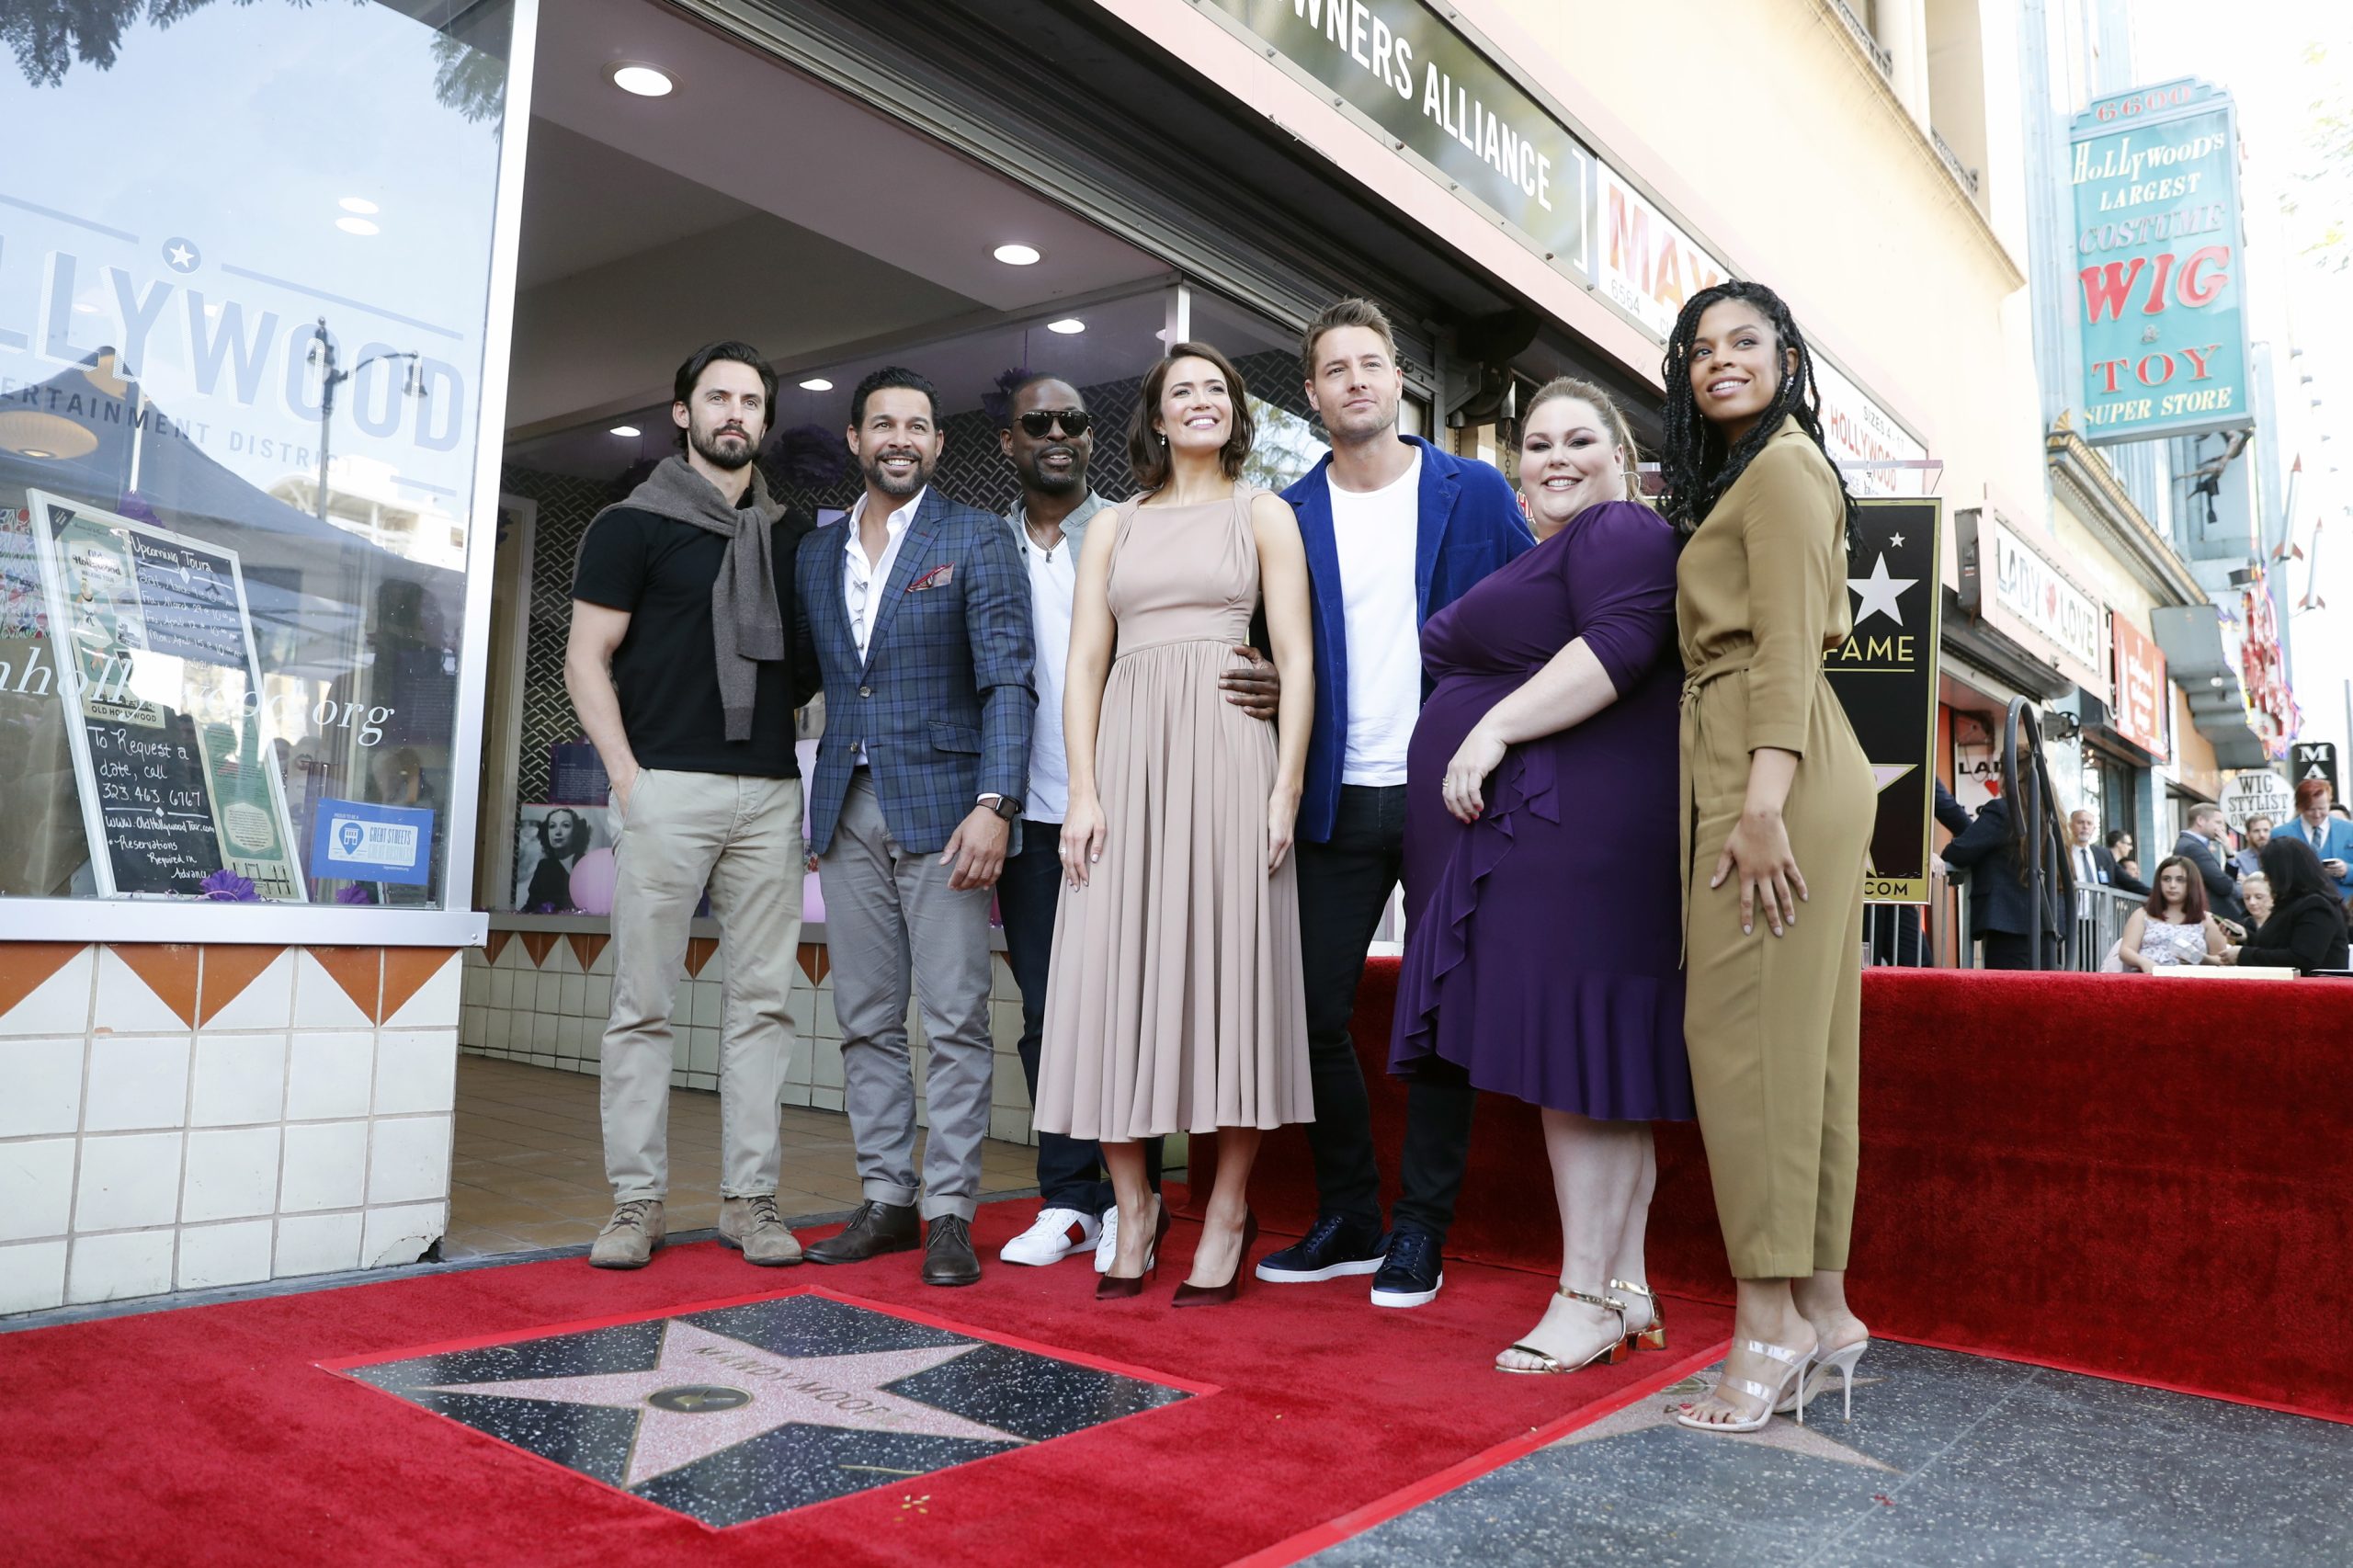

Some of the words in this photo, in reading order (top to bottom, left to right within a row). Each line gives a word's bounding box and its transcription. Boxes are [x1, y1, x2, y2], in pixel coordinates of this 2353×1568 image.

[1279, 0, 1414, 100] NERS
[1423, 61, 1552, 213] ALLIANCE
[2095, 85, 2192, 124] 6600
[2098, 171, 2201, 213] LARGEST
[2078, 200, 2226, 256] COSTUME
[1611, 278, 1641, 315] 6564
[2078, 244, 2231, 324] WIG
[2140, 324, 2161, 345] &
[2091, 344, 2222, 395] TOY
[1863, 405, 1885, 436] SIZES
[2084, 398, 2152, 427] SUPER
[2160, 386, 2233, 417] STORE
[1830, 403, 1897, 492] HOLLYWOOD
[131, 535, 180, 570] Upcoming
[1996, 537, 2040, 618] LADY
[2061, 590, 2095, 657] LOVE
[92, 705, 108, 715] OLD
[87, 726, 108, 749] To
[110, 728, 172, 762] Request
[177, 746, 189, 760] a
[99, 758, 138, 781] date,
[143, 764, 168, 779] call
[2238, 775, 2273, 794] WIG
[2228, 793, 2289, 812] STYLIST
[2230, 813, 2246, 827] ON
[2260, 811, 2288, 825] TY
[369, 826, 387, 843] GREAT
[387, 829, 412, 846] STREETS
[147, 852, 185, 868] Required
[692, 1346, 804, 1383] MANDY
[788, 1381, 915, 1421] MOO
